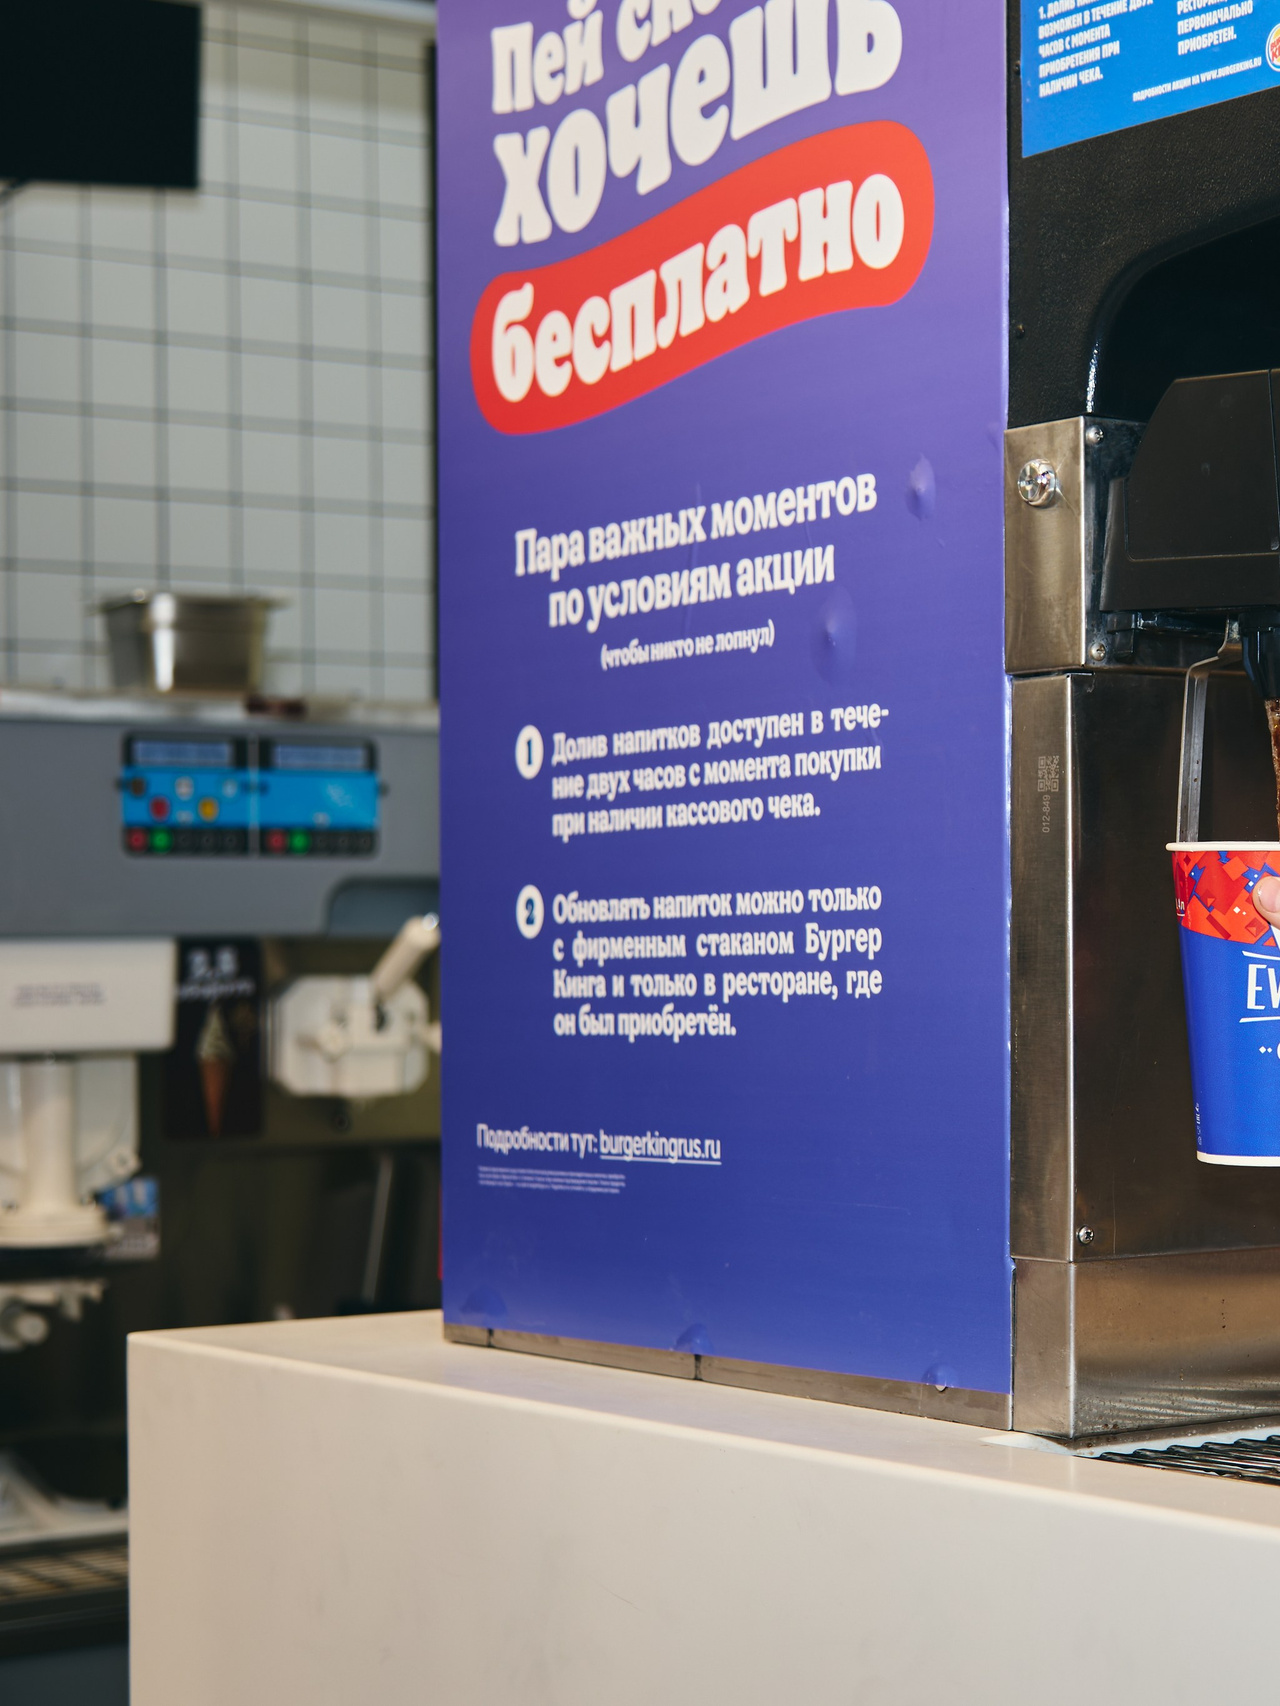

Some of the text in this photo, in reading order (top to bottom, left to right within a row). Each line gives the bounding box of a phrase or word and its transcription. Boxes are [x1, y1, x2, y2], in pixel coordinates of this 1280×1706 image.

[1038, 12, 1083, 40] ВОЗМОЖЕН
[1083, 10, 1091, 25] В
[1091, 0, 1128, 22] ТЕЧЕНИЕ
[1177, 0, 1254, 35] ПЕРВОНАЧАЛЬНО
[491, 0, 604, 114] Пей
[1038, 23, 1111, 59] ЧАСОВ С МОМЕНТА
[1039, 40, 1121, 78] ПРИОБРЕТЕНИЯ ПРИ
[1178, 25, 1237, 56] ПРИОБРЕТЕН.
[1038, 66, 1104, 99] НАЛИЧИИ ЧЕКА.
[493, 0, 903, 247] хочешь
[492, 173, 904, 402] бесплатно
[515, 473, 877, 582] Пара важных моментов
[549, 544, 835, 633] по условиям акции
[601, 618, 775, 671] (чтобы никто не лопнул)
[551, 703, 889, 766] Долив напитков доступен в тече-
[551, 745, 882, 802] ние двух часов с момента покупки
[551, 792, 821, 843] при наличии кассового чека.
[1042, 794, 1051, 833] 012-849
[552, 885, 882, 924] Обновлять напиток можно только
[552, 922, 882, 968] с фирменным стаканом Бургер
[552, 968, 882, 1004] Кинга и только в ресторане, где
[553, 1002, 737, 1043] он был приобретён.
[476, 1123, 721, 1164] Подробности тут: burgerkingrus.ru
